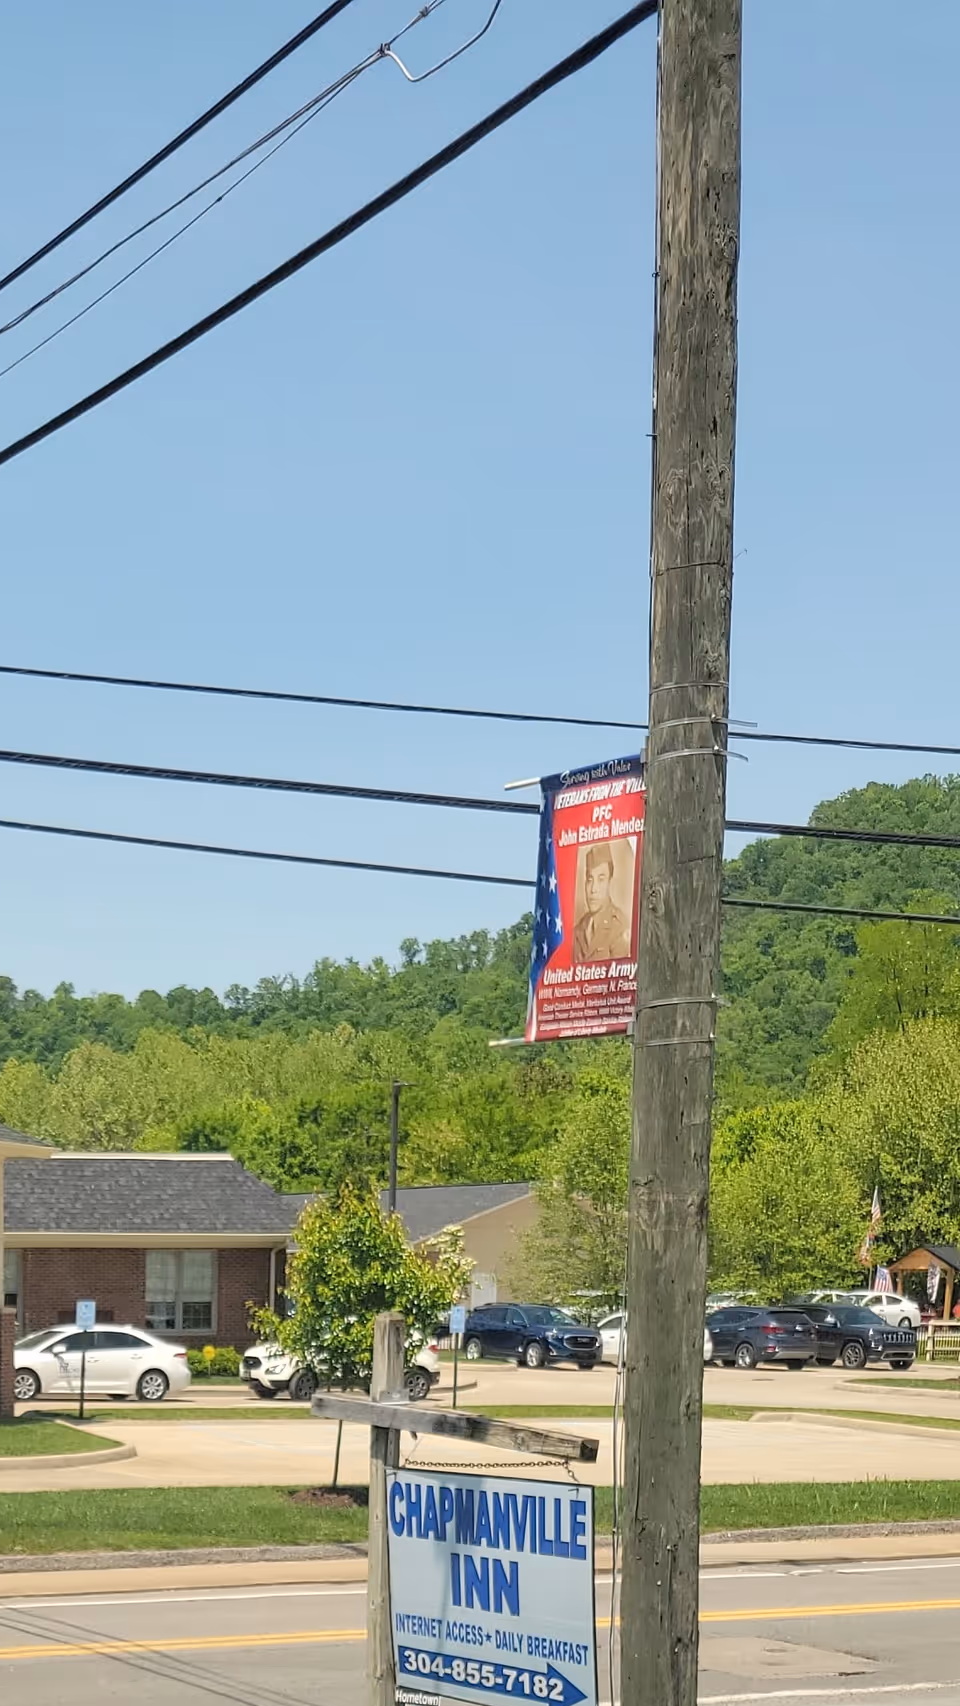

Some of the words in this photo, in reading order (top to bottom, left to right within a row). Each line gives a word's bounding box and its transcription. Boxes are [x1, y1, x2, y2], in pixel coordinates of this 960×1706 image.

[588, 783, 611, 802] FROM
[609, 779, 626, 798] THE
[592, 803, 613, 822] PFC
[558, 828, 578, 847] John
[578, 822, 610, 843] Estrada
[611, 816, 645, 837] Mendez
[543, 966, 573, 985] United
[574, 964, 607, 982] States
[608, 961, 637, 979] Army
[389, 1481, 587, 1560] CHAPMANVILLE
[450, 1552, 520, 1616] INN
[395, 1613, 442, 1640] INTERNET
[445, 1621, 483, 1646] ACCESS
[495, 1629, 523, 1654] DAILY
[527, 1634, 588, 1666] BREAKFAST
[403, 1650, 564, 1701] 304-855-7182
[395, 1689, 439, 1706] Hometown
